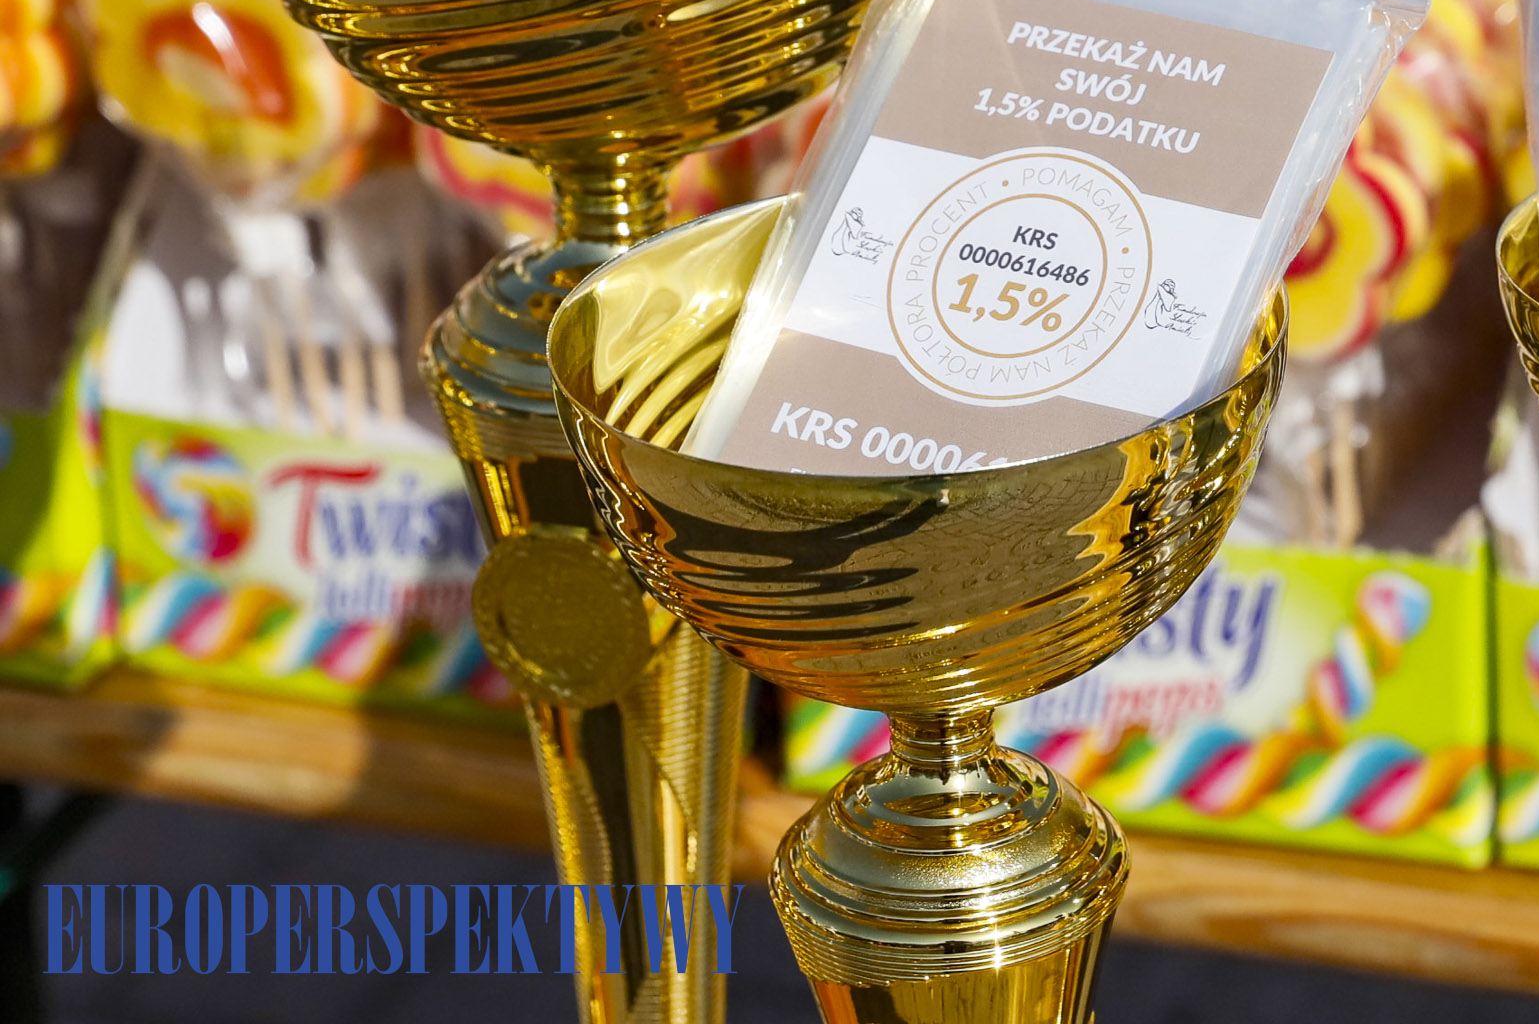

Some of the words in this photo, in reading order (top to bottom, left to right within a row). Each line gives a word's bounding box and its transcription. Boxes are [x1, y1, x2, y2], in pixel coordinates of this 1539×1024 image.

[1007, 21, 1148, 70] PRZEKAŻ
[1147, 50, 1226, 87] NAM
[1054, 67, 1147, 105] SWÓJ
[974, 88, 1045, 121] 1,5%
[1045, 102, 1200, 154] PODATKU
[905, 181, 989, 281] PROCENT
[1022, 167, 1133, 237] POMAGAM
[958, 243, 1091, 287] 0000616486
[1012, 225, 1059, 250] KRS
[948, 273, 1071, 332] 1,5%
[1057, 267, 1136, 366] PRZEKAŻ
[905, 293, 982, 380] PÓŁTORA
[990, 357, 1052, 383] NAM
[770, 402, 858, 450] KRS
